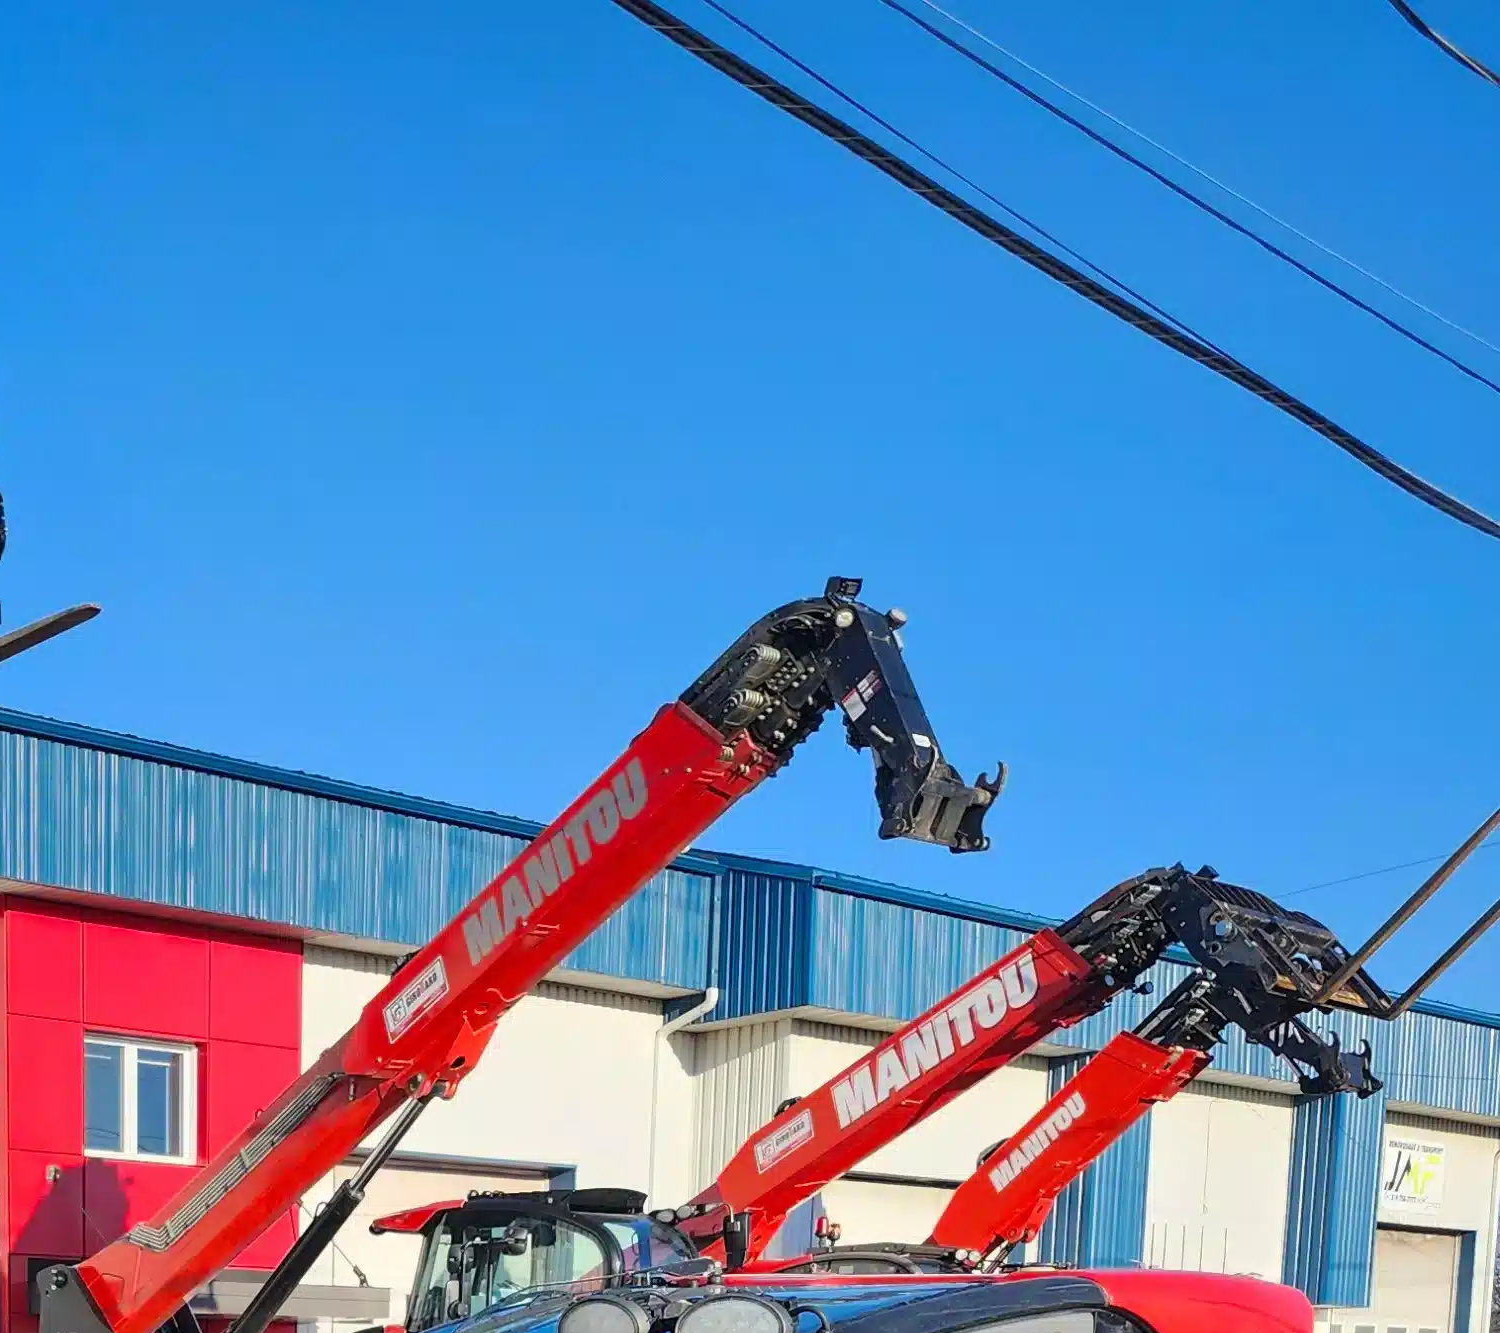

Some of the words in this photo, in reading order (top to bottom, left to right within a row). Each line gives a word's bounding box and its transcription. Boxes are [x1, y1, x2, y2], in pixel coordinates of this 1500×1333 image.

[461, 756, 649, 967] MANITOU
[830, 951, 1040, 1131] MANITOU
[987, 1091, 1088, 1193] MANITOU
